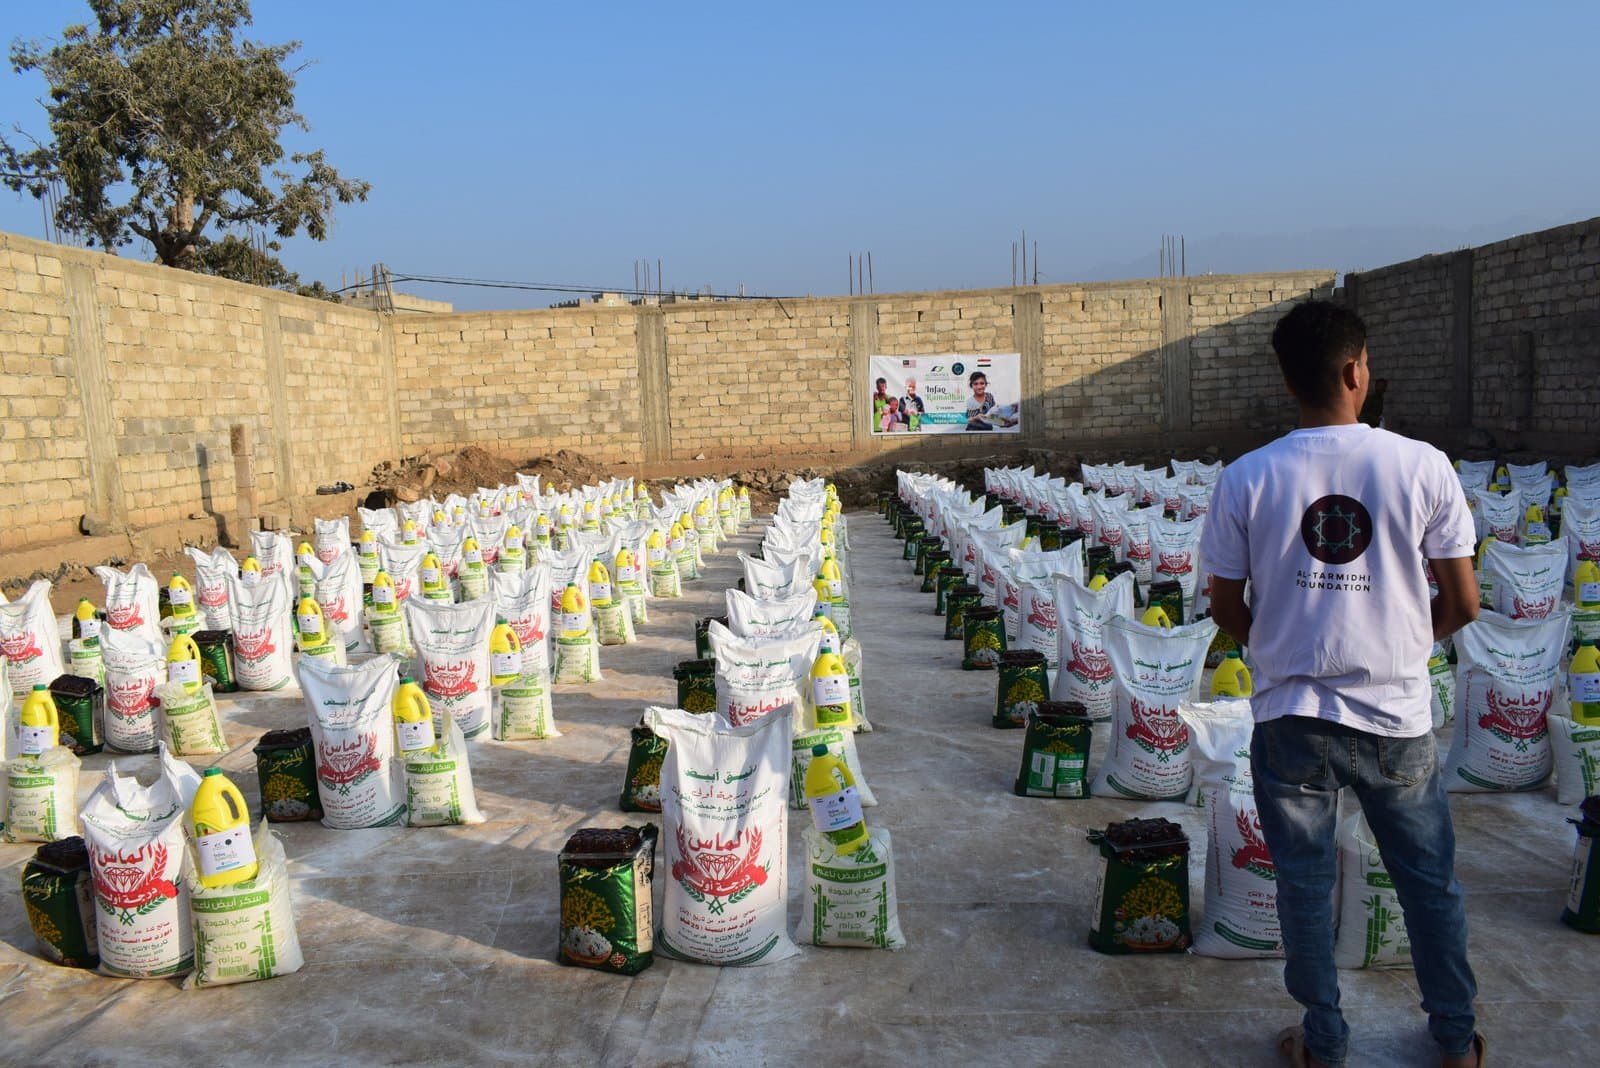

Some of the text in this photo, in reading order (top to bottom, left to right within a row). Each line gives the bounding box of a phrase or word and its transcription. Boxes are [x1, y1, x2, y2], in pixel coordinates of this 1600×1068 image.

[926, 385, 948, 395] Infaq
[1296, 570, 1371, 582] AL-TARMIDHI
[1296, 579, 1371, 592] FOUNDATION
[1141, 703, 1179, 718] ماس
[325, 732, 368, 757] الماس
[687, 827, 750, 852] الماس
[97, 842, 153, 868] الماس
[683, 872, 752, 893] درجة أولى
[123, 887, 158, 904] درجة
[855, 910, 866, 918] 10
[234, 941, 247, 951] 10
